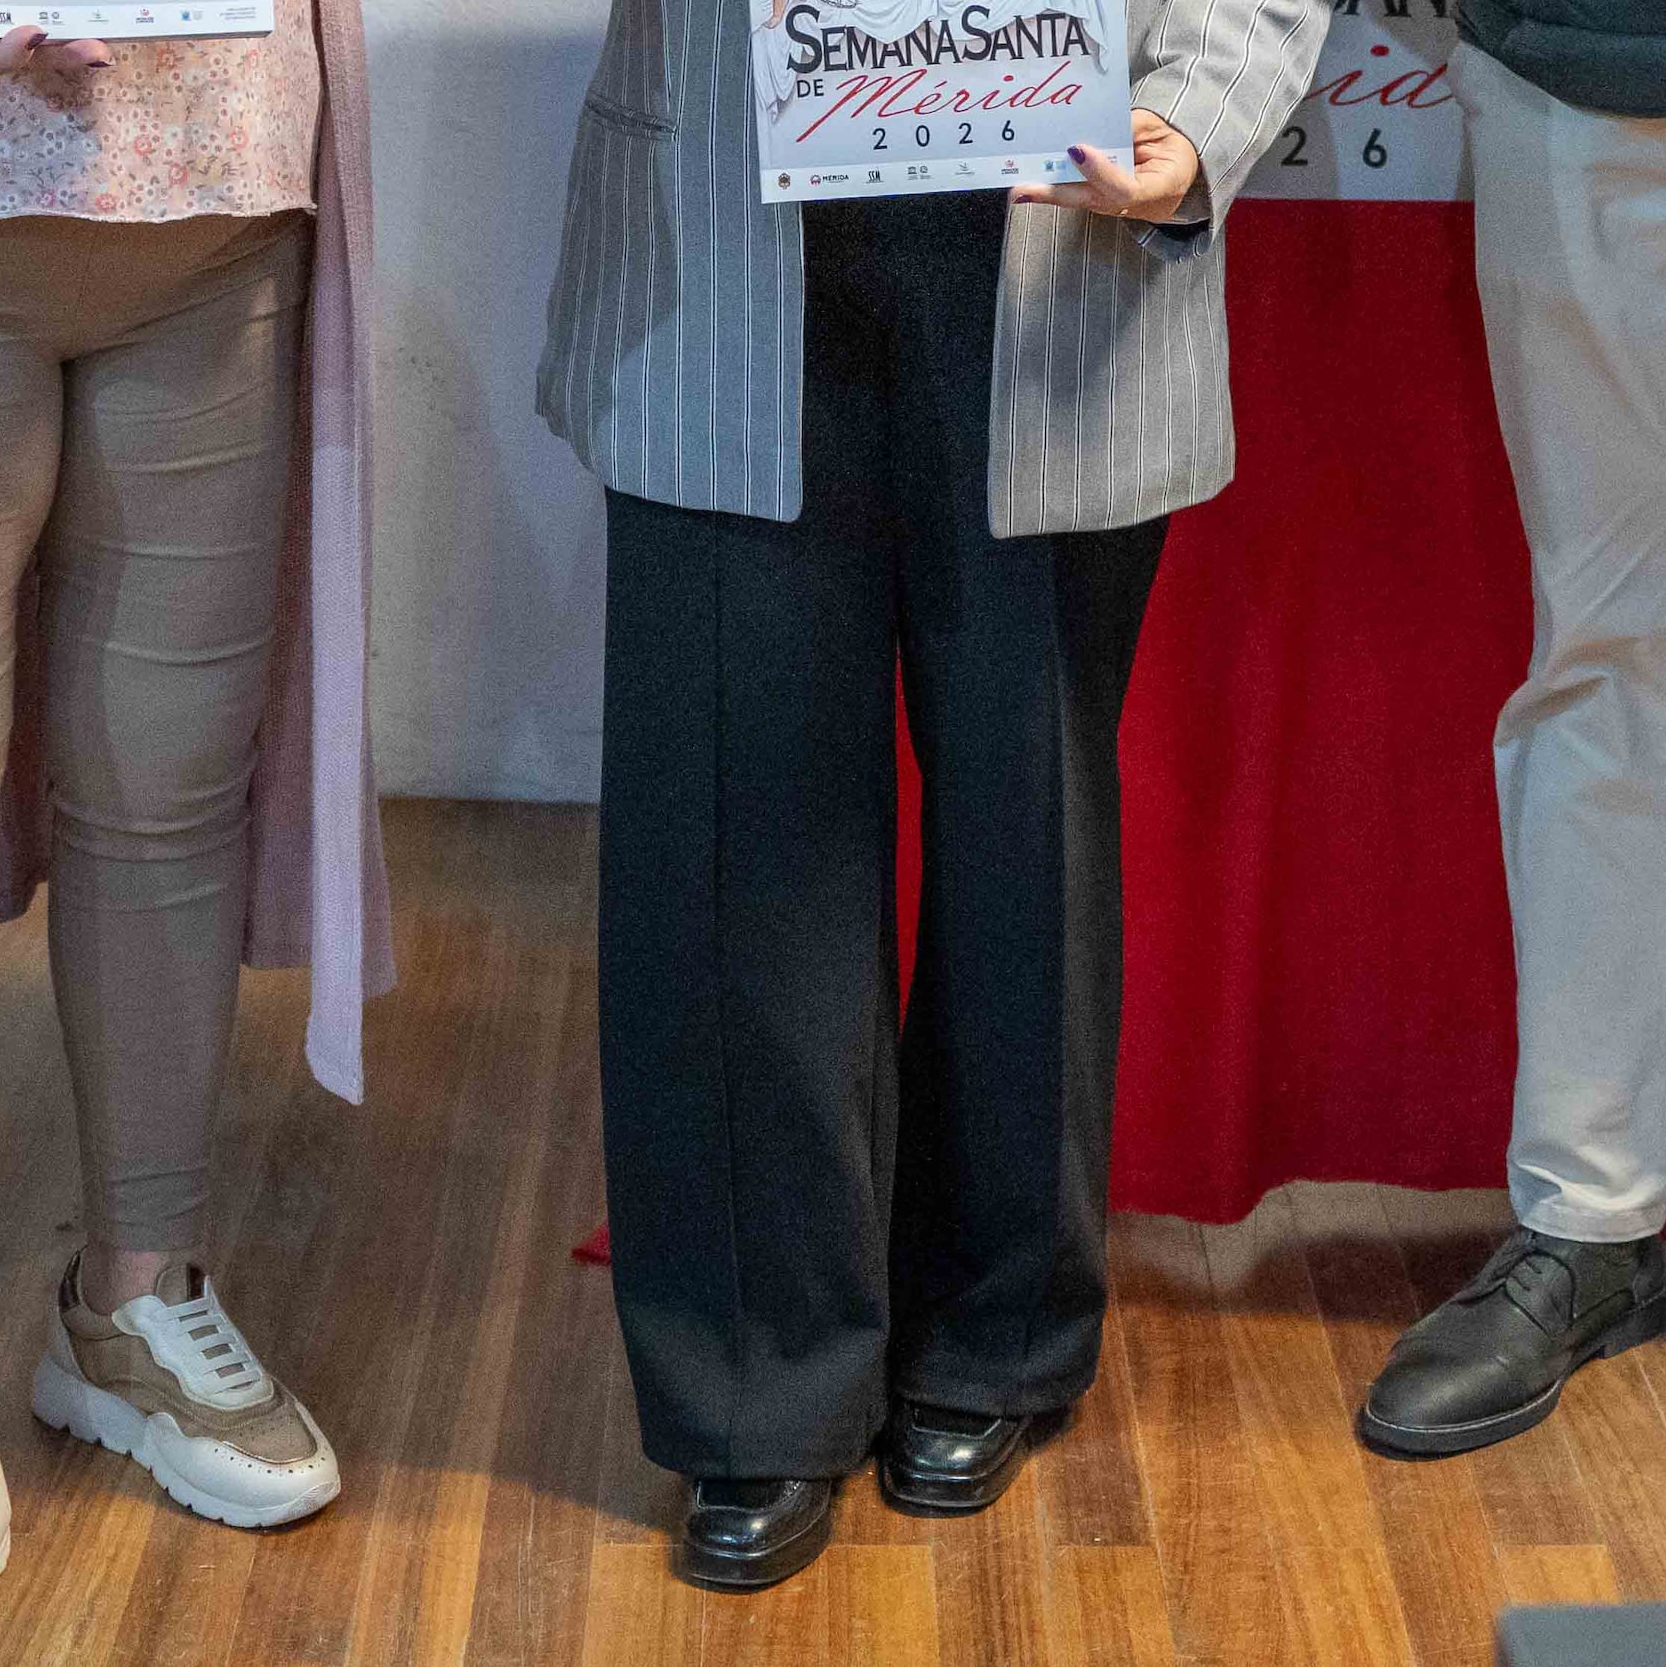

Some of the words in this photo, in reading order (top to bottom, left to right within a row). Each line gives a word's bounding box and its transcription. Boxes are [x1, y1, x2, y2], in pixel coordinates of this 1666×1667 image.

[961, 5, 1091, 61] SANTA
[795, 60, 1082, 143] Mérida
[796, 79, 824, 99] DE
